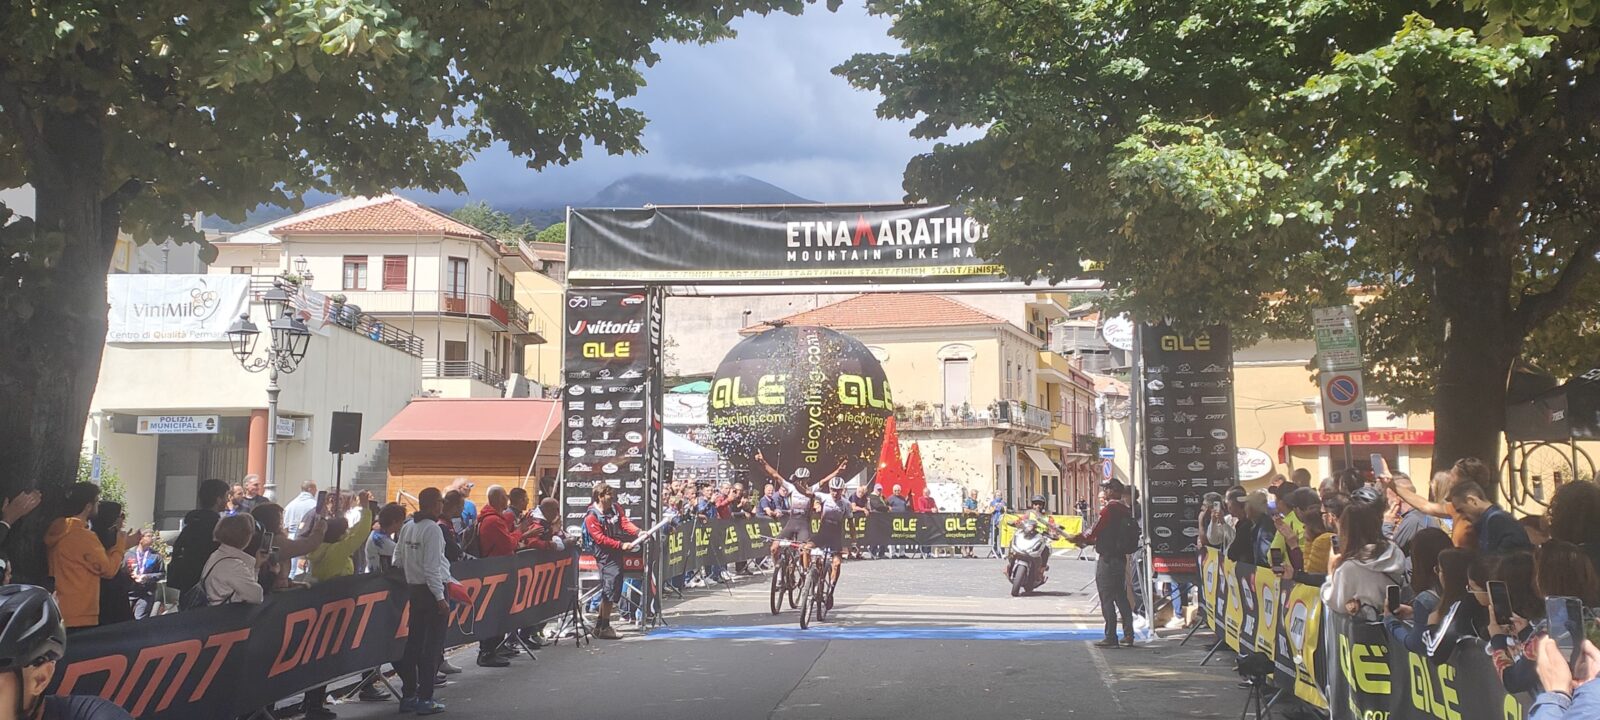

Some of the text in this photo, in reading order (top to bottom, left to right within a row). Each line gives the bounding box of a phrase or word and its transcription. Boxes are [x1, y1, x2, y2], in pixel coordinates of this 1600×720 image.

[787, 249, 881, 262] MOUNTAIN
[895, 246, 940, 260] BIKE
[788, 268, 854, 277] START/FINISH
[859, 267, 926, 276] START/FINISH
[109, 331, 140, 339] Centro
[142, 330, 151, 339] di
[153, 330, 187, 339] Qualità
[587, 319, 642, 335] vittoria
[150, 422, 203, 430] MUNICIPALE
[1319, 432, 1371, 443] Cinue
[509, 556, 573, 615] DMT
[267, 590, 390, 679] DMT
[55, 627, 252, 719] DMT
